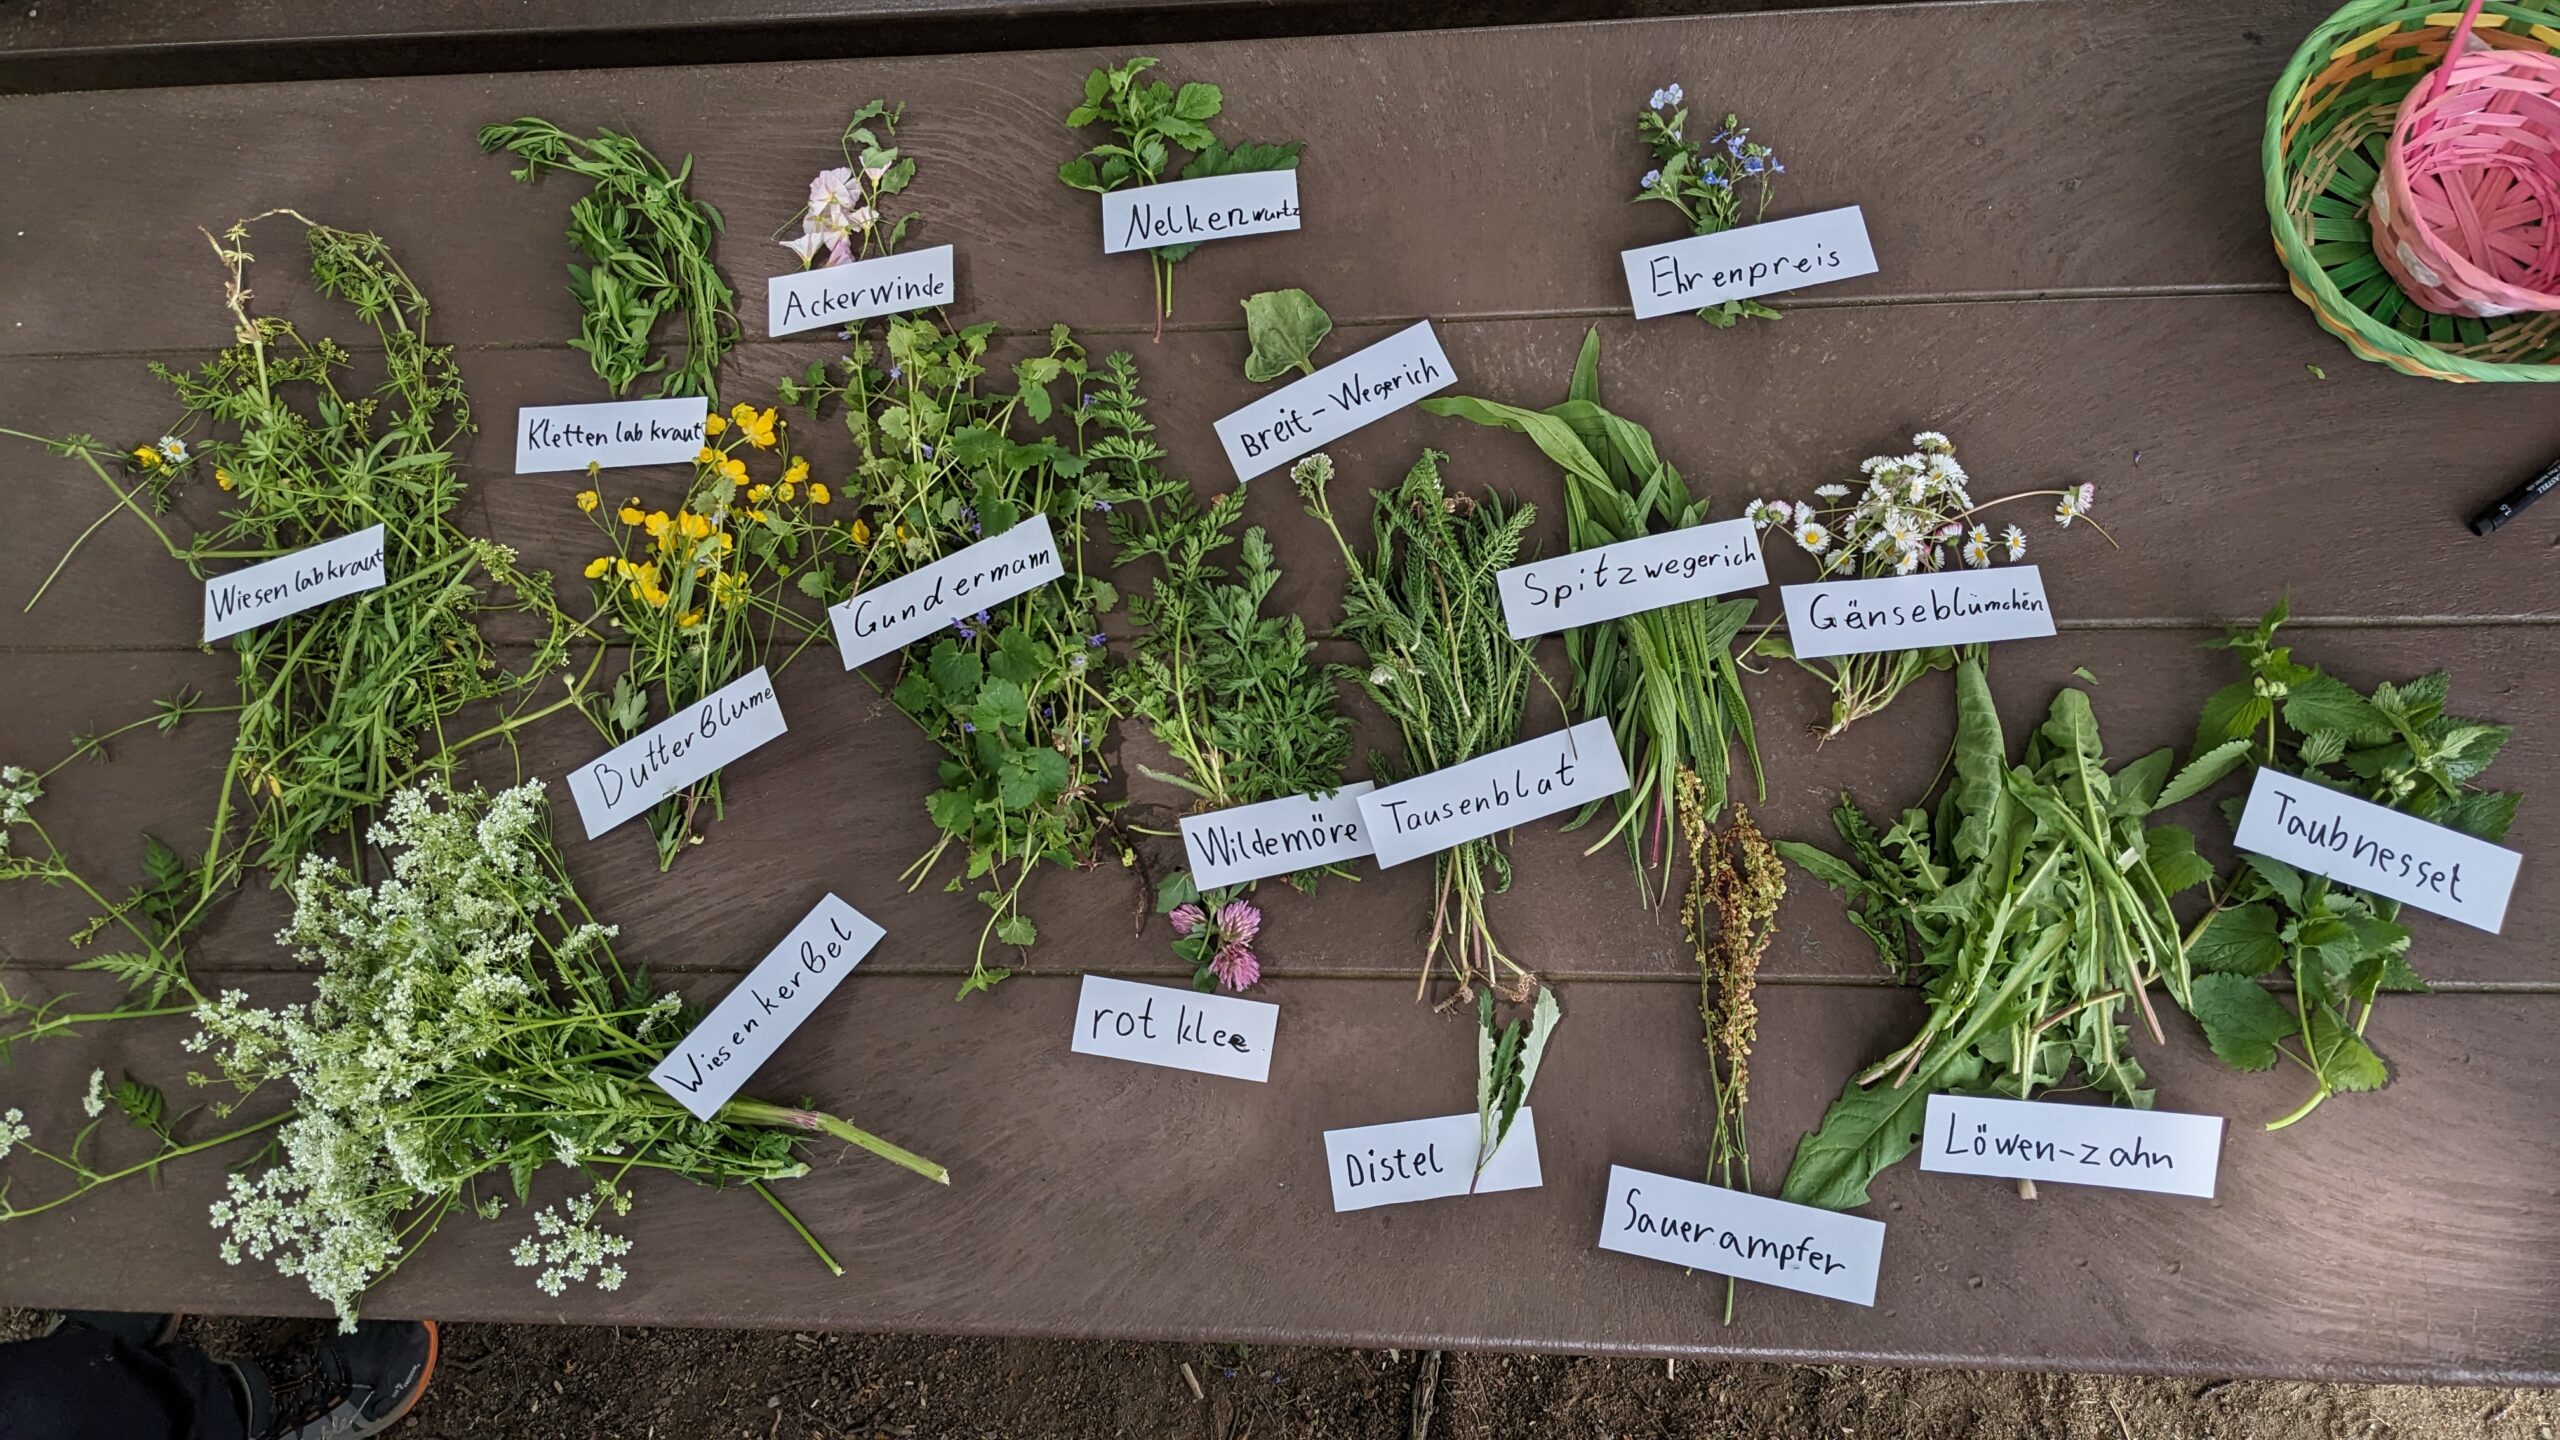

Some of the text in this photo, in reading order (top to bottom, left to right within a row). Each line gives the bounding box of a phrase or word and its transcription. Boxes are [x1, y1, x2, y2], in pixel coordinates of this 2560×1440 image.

[1650, 243, 1840, 297] Ehrenpreis
[854, 548, 1050, 638] Gundermann
[1524, 536, 1756, 609] Spitzwegerich
[1381, 752, 1576, 834] Tausenblat
[1191, 813, 1358, 866] Wildemöre
[1092, 997, 1250, 1053] rot klee
[1346, 1143, 1444, 1188] Distel
